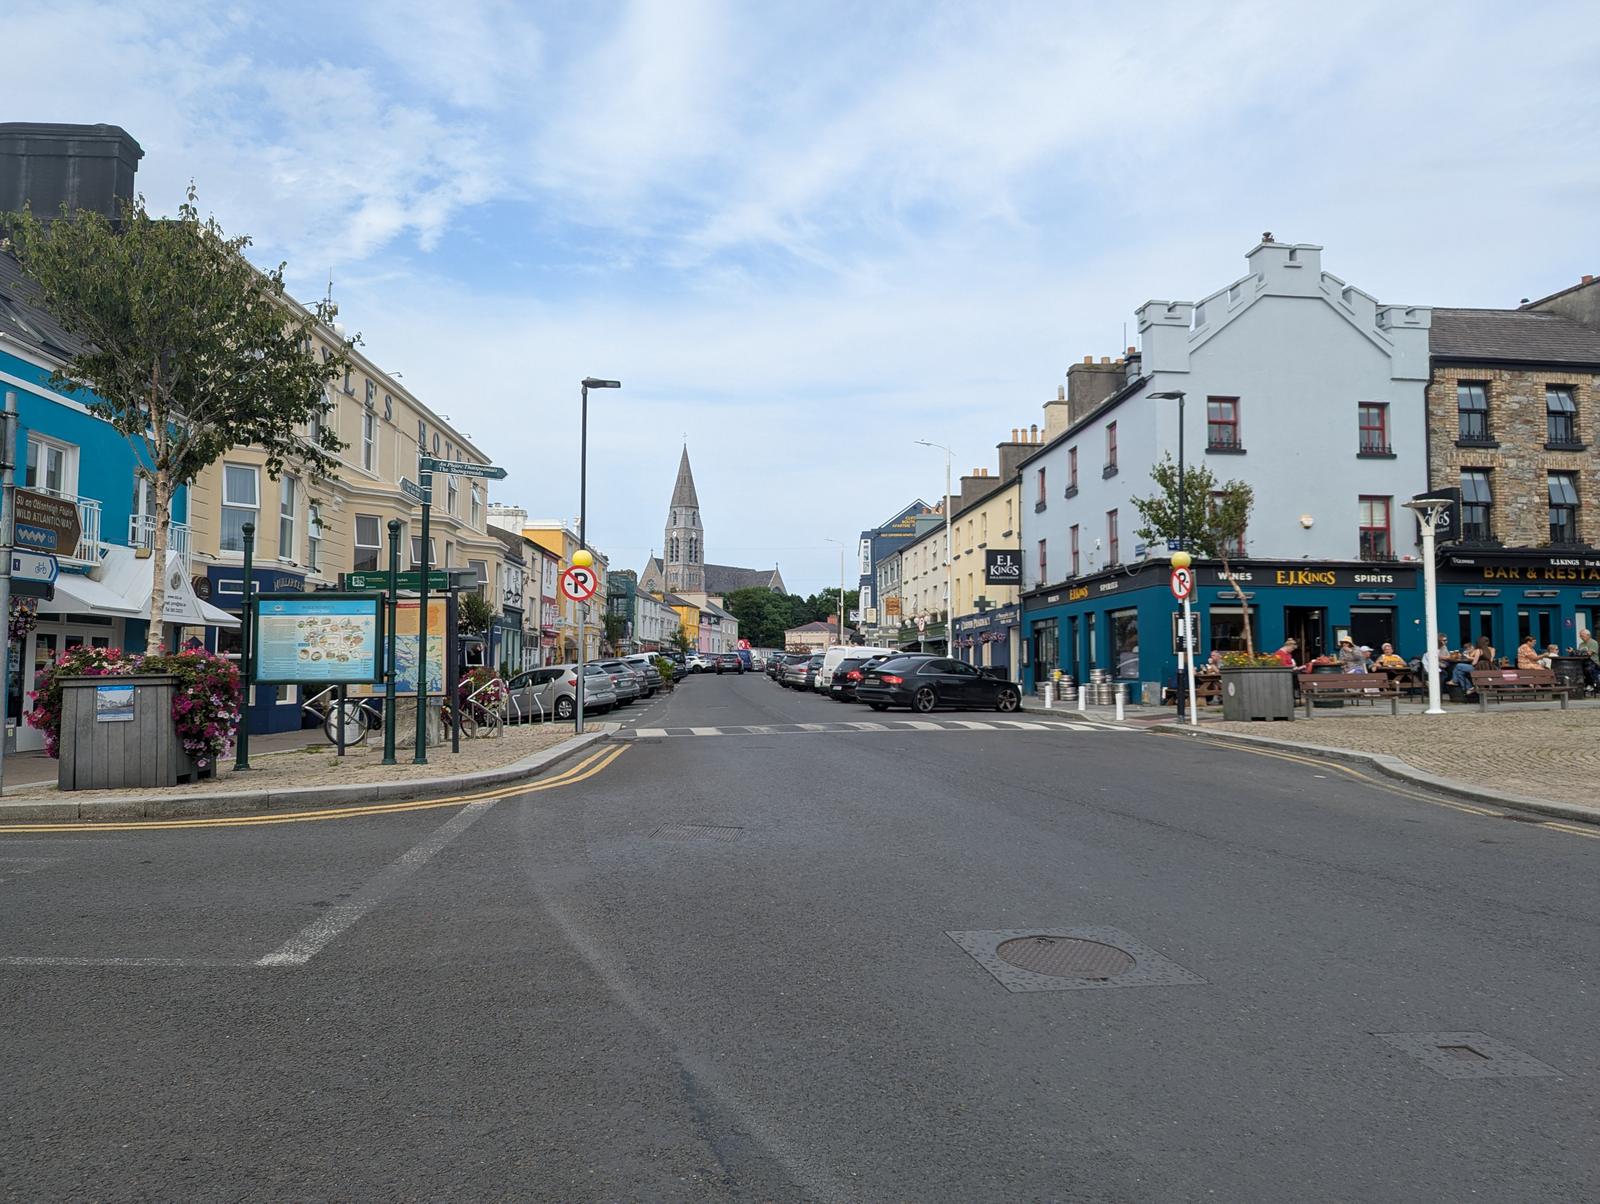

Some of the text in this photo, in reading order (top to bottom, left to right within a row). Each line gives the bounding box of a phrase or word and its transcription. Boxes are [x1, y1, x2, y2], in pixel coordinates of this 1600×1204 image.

[418, 419, 470, 464] HOTE
[450, 468, 484, 476] Showgrounds
[16, 508, 73, 530] WILD ATLANTIC WAY
[1217, 572, 1252, 581] WNES
[1354, 574, 1393, 583] SPIRITS
[1483, 566, 1520, 579] BAR
[1526, 567, 1537, 579] &
